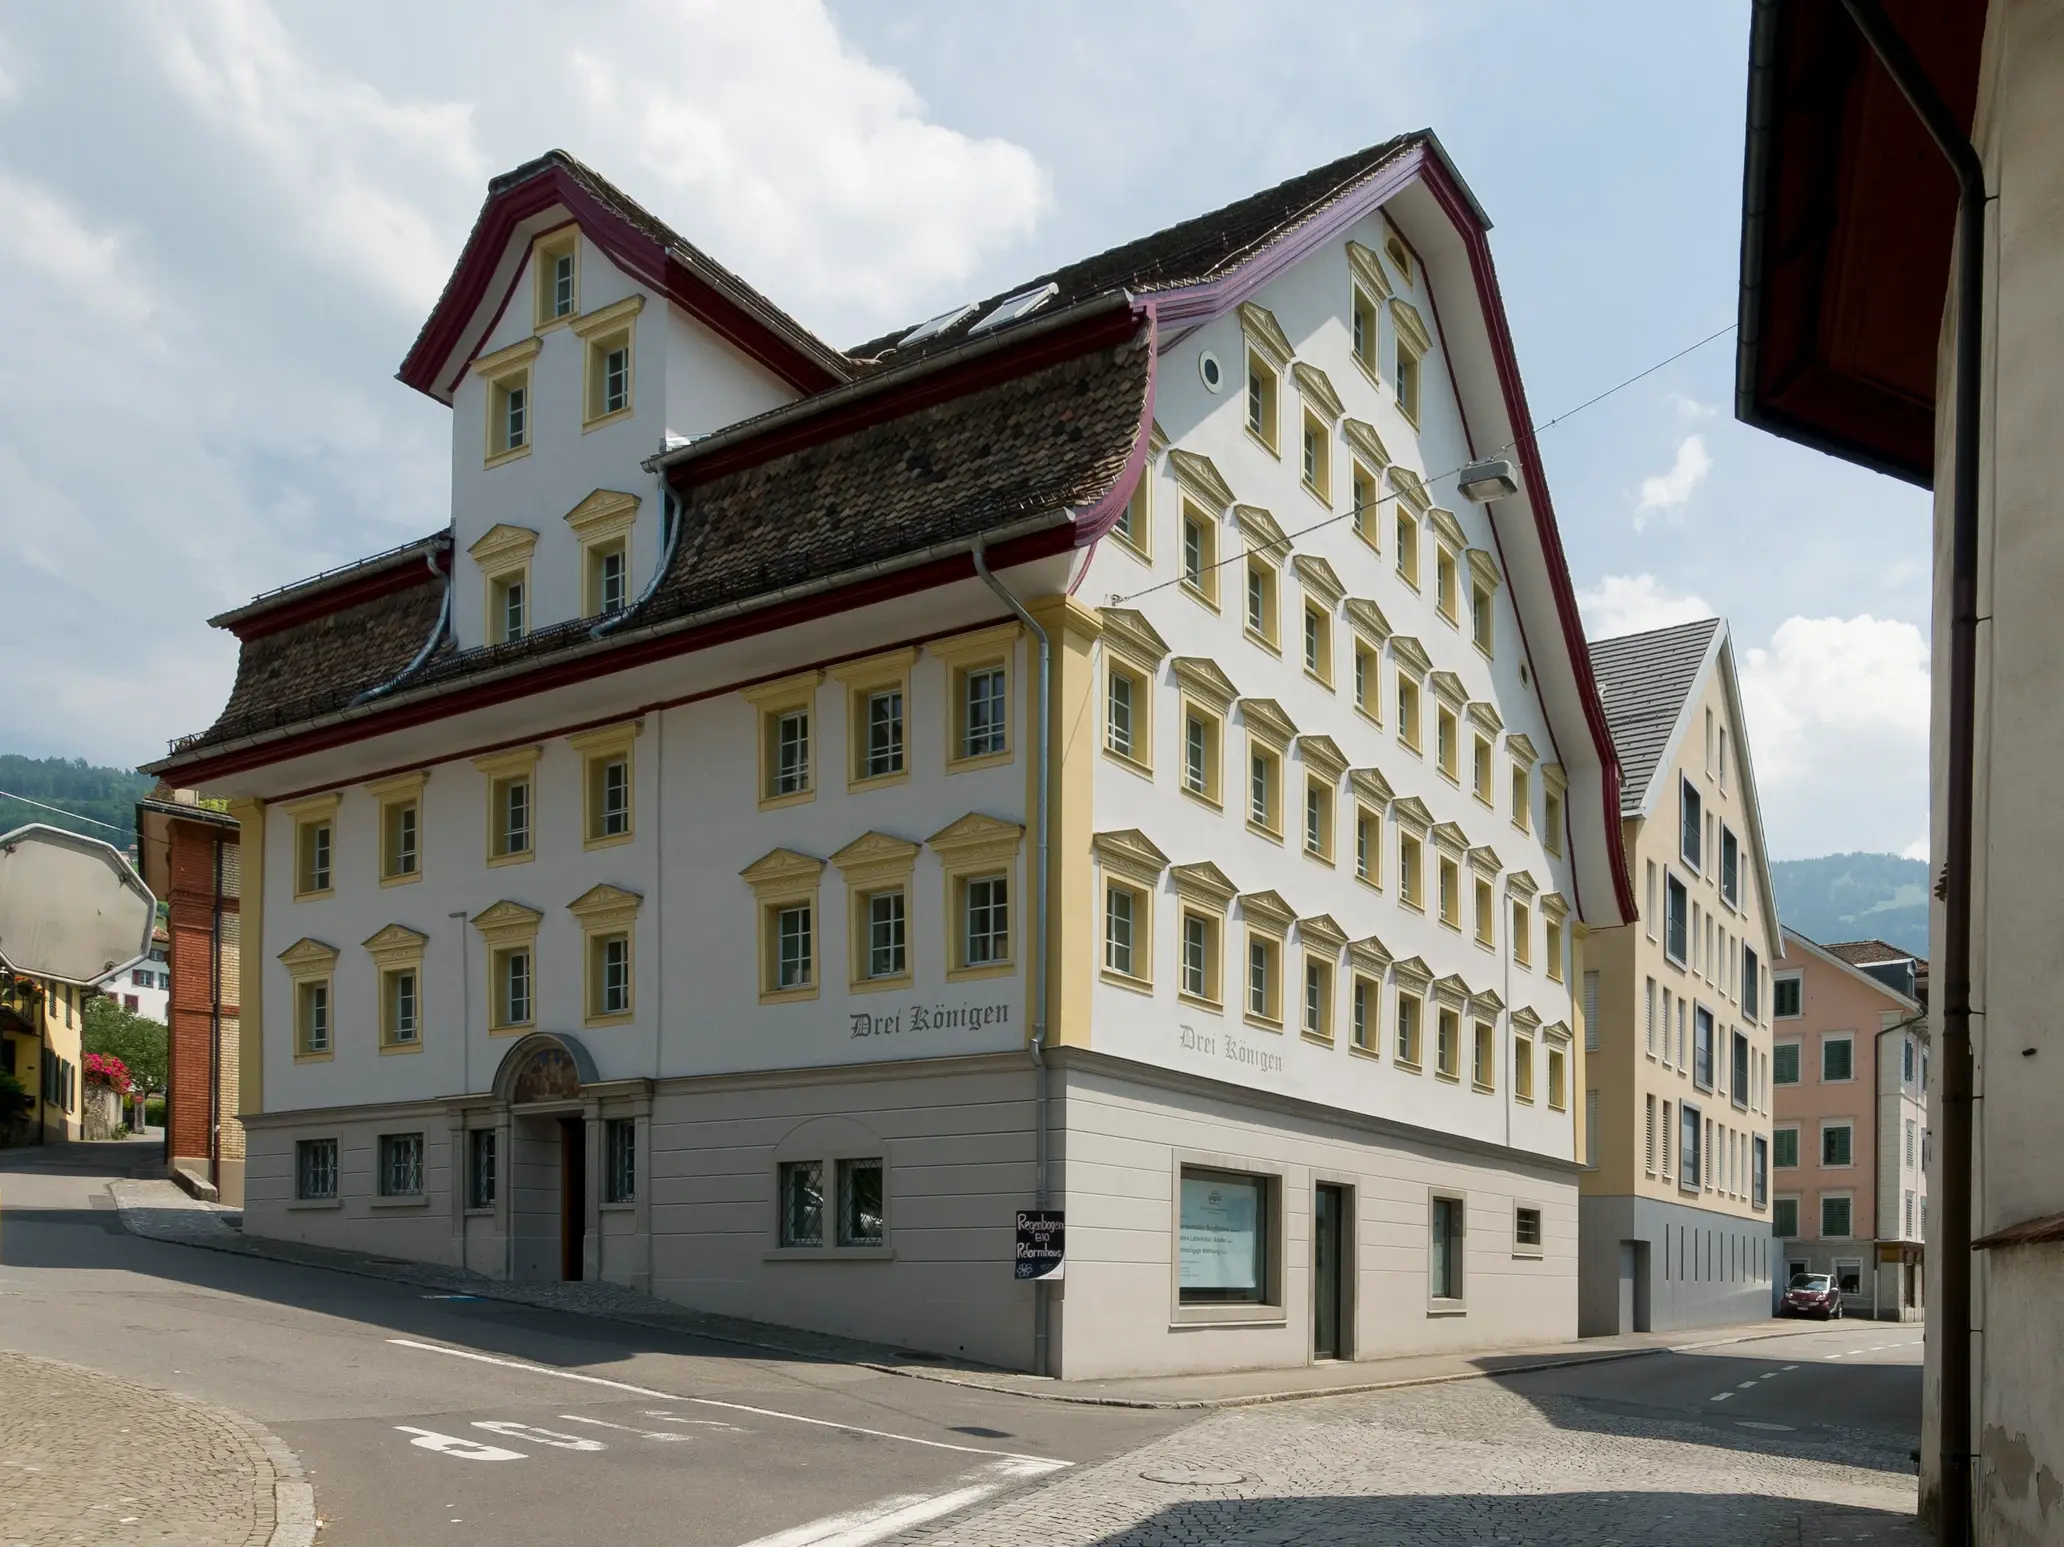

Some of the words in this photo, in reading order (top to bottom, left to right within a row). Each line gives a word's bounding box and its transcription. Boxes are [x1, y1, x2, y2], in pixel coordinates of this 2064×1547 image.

[849, 1008, 901, 1040] Drei
[908, 1002, 1009, 1032] Königen
[1179, 1023, 1216, 1056] Drei
[1223, 1034, 1283, 1073] Königen
[1017, 1213, 1064, 1234] Regenbogen
[1016, 1242, 1062, 1259] Reformhaus
